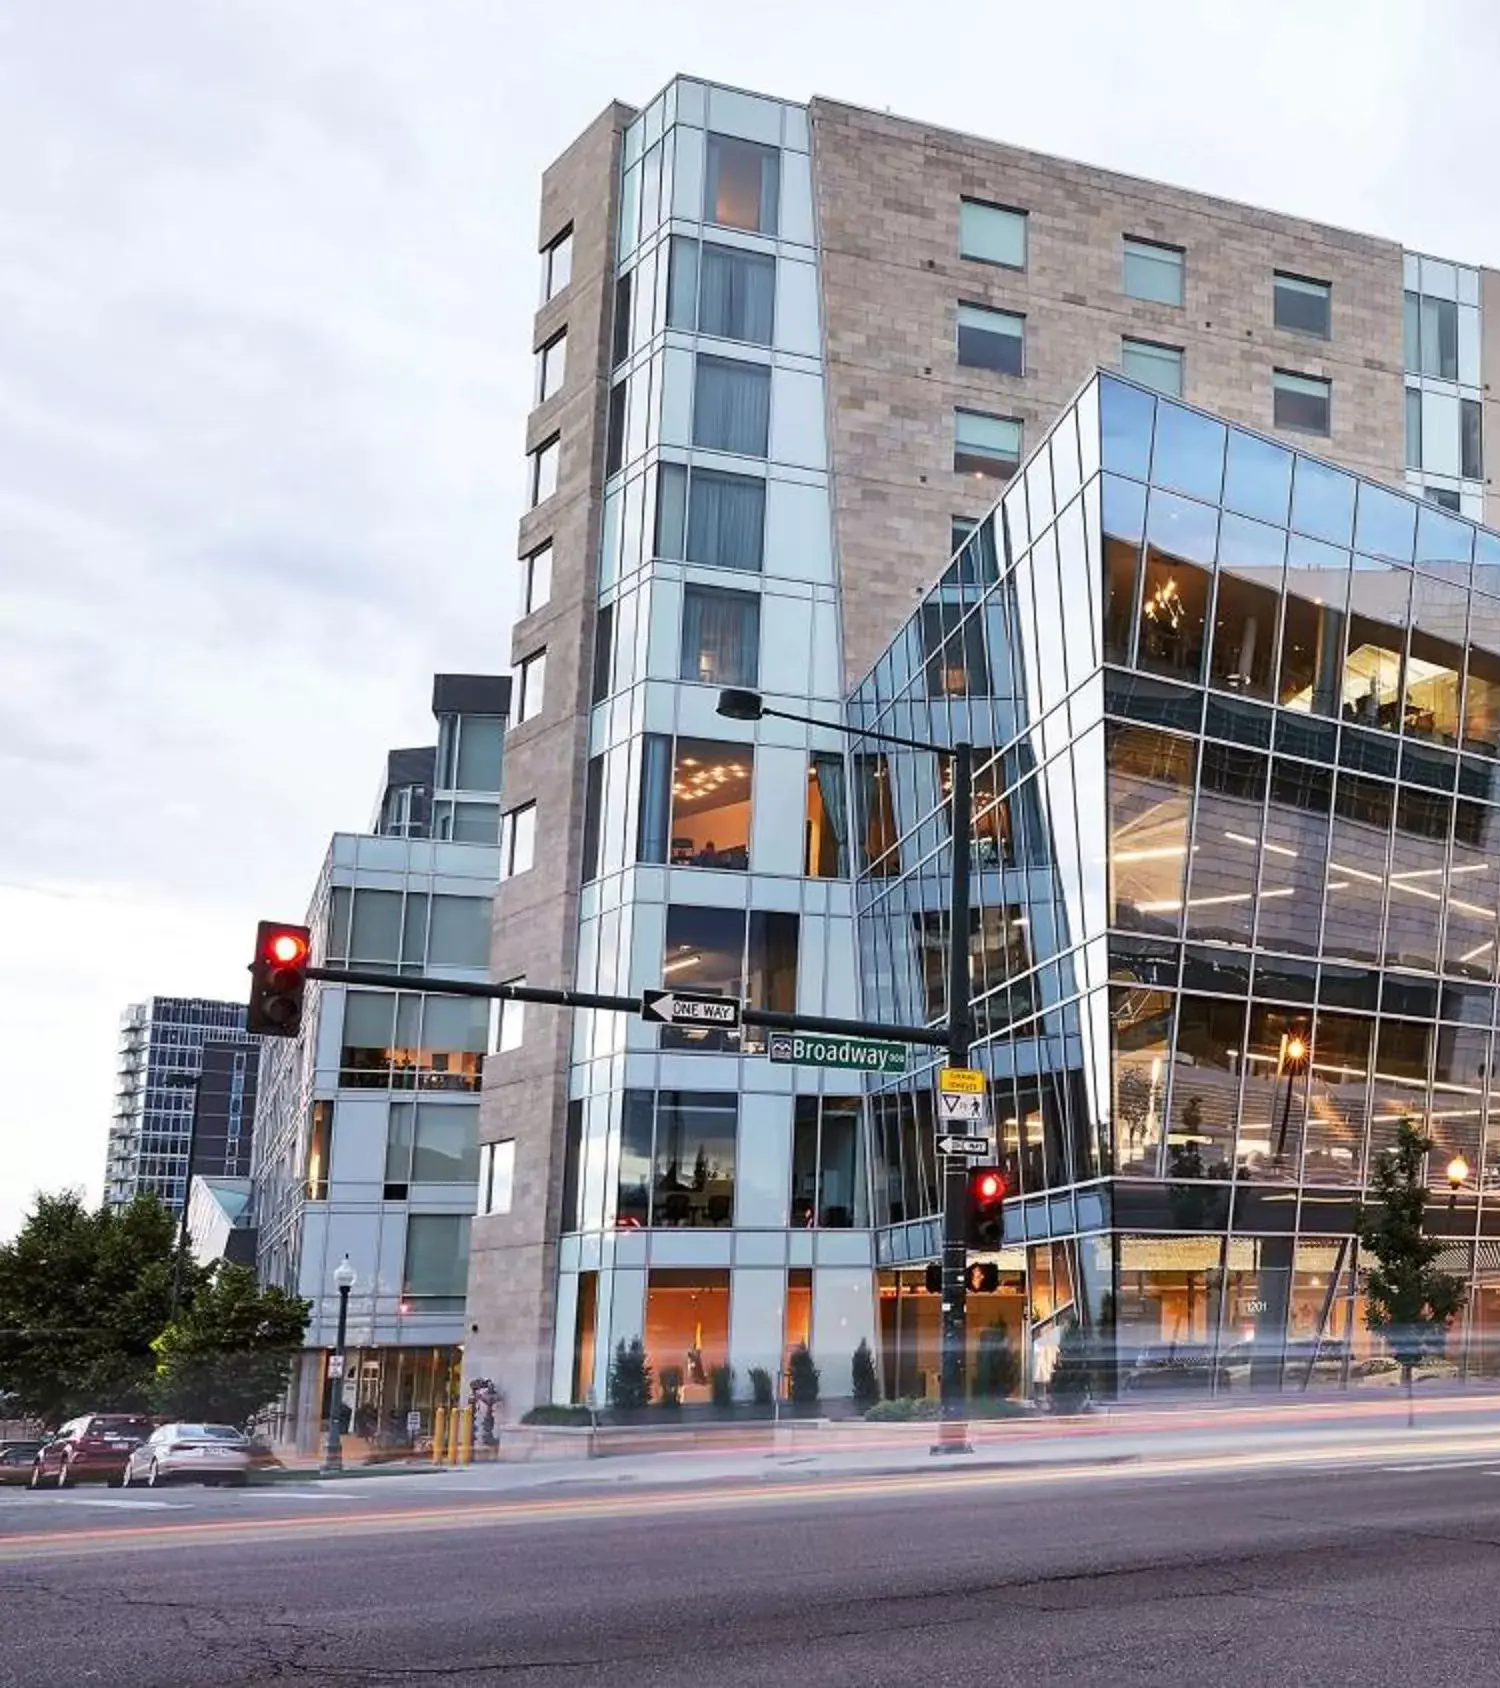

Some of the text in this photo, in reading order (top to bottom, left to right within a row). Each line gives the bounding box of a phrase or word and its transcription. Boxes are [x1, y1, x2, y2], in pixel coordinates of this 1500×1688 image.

[673, 1001, 731, 1018] ONE WAY
[794, 1039, 888, 1070] Broadway
